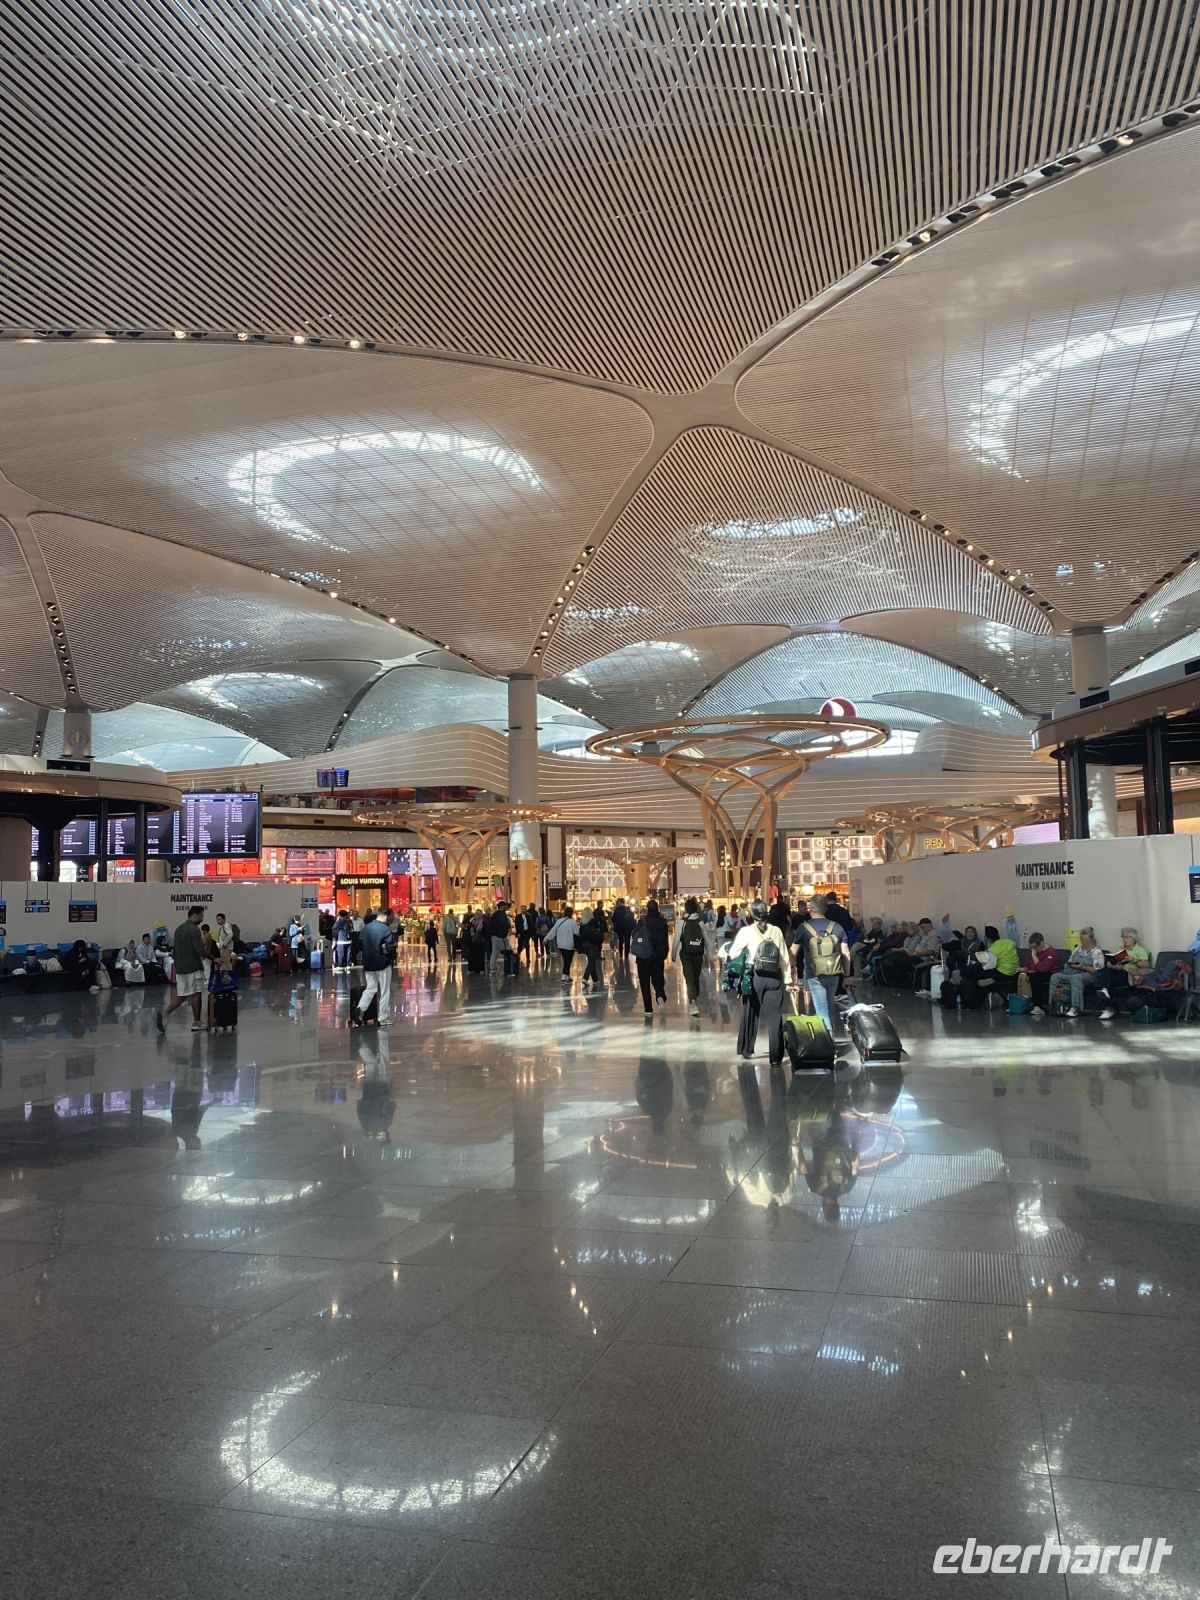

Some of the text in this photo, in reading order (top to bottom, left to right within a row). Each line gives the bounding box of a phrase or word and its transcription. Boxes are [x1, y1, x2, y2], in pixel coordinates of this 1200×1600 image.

[816, 838, 856, 847] GUCCI
[924, 838, 955, 849] FENI
[1015, 861, 1074, 877] MAINTENANCE
[340, 877, 358, 885] LOUIS
[1021, 880, 1066, 891] BAKIM ONARIM
[170, 894, 213, 903] MAINTENANCE
